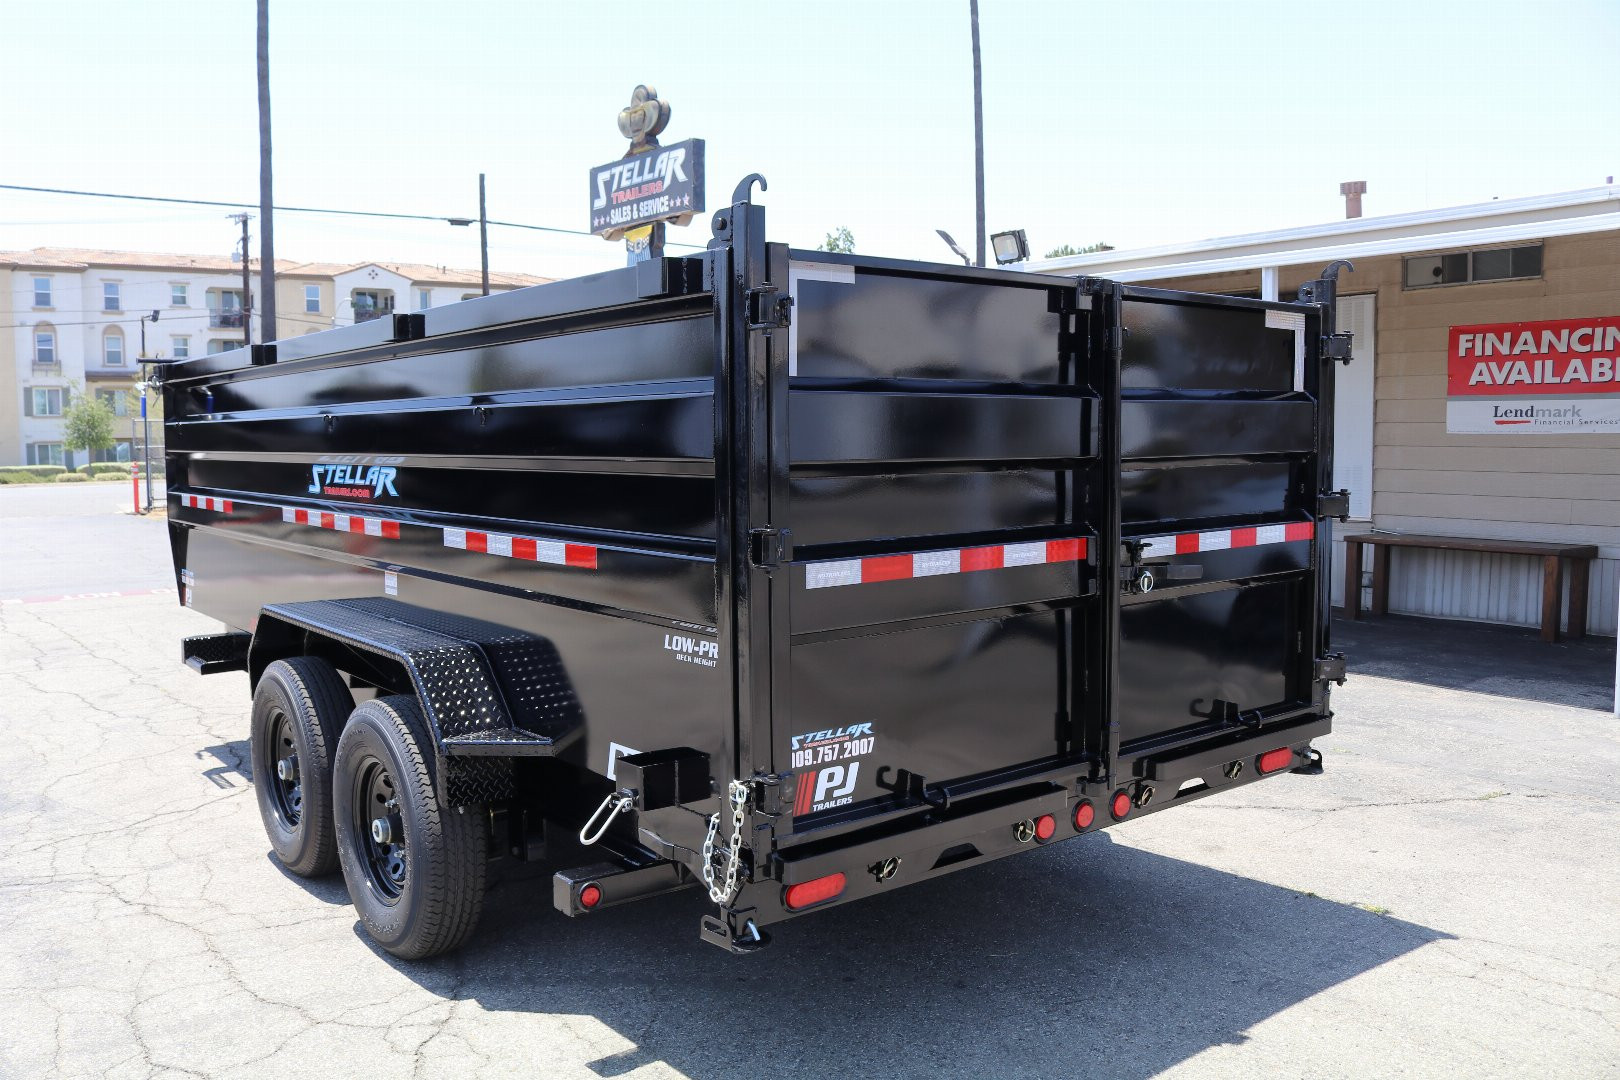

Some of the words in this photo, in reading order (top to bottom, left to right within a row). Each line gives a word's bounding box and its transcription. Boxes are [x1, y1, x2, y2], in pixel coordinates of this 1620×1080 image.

[593, 148, 688, 210] STELLAR
[611, 180, 664, 204] TRAILERS
[610, 207, 632, 225] SALES
[633, 204, 639, 219] &
[639, 195, 669, 217] SERVICE
[1493, 405, 1582, 418] Lendmark
[308, 464, 400, 499] STELLAR
[676, 653, 692, 663] DECK
[694, 657, 717, 668] HEIGHT
[791, 722, 874, 750] STELLAR
[813, 761, 860, 802] PJ
[812, 796, 853, 812] TRAILERS
